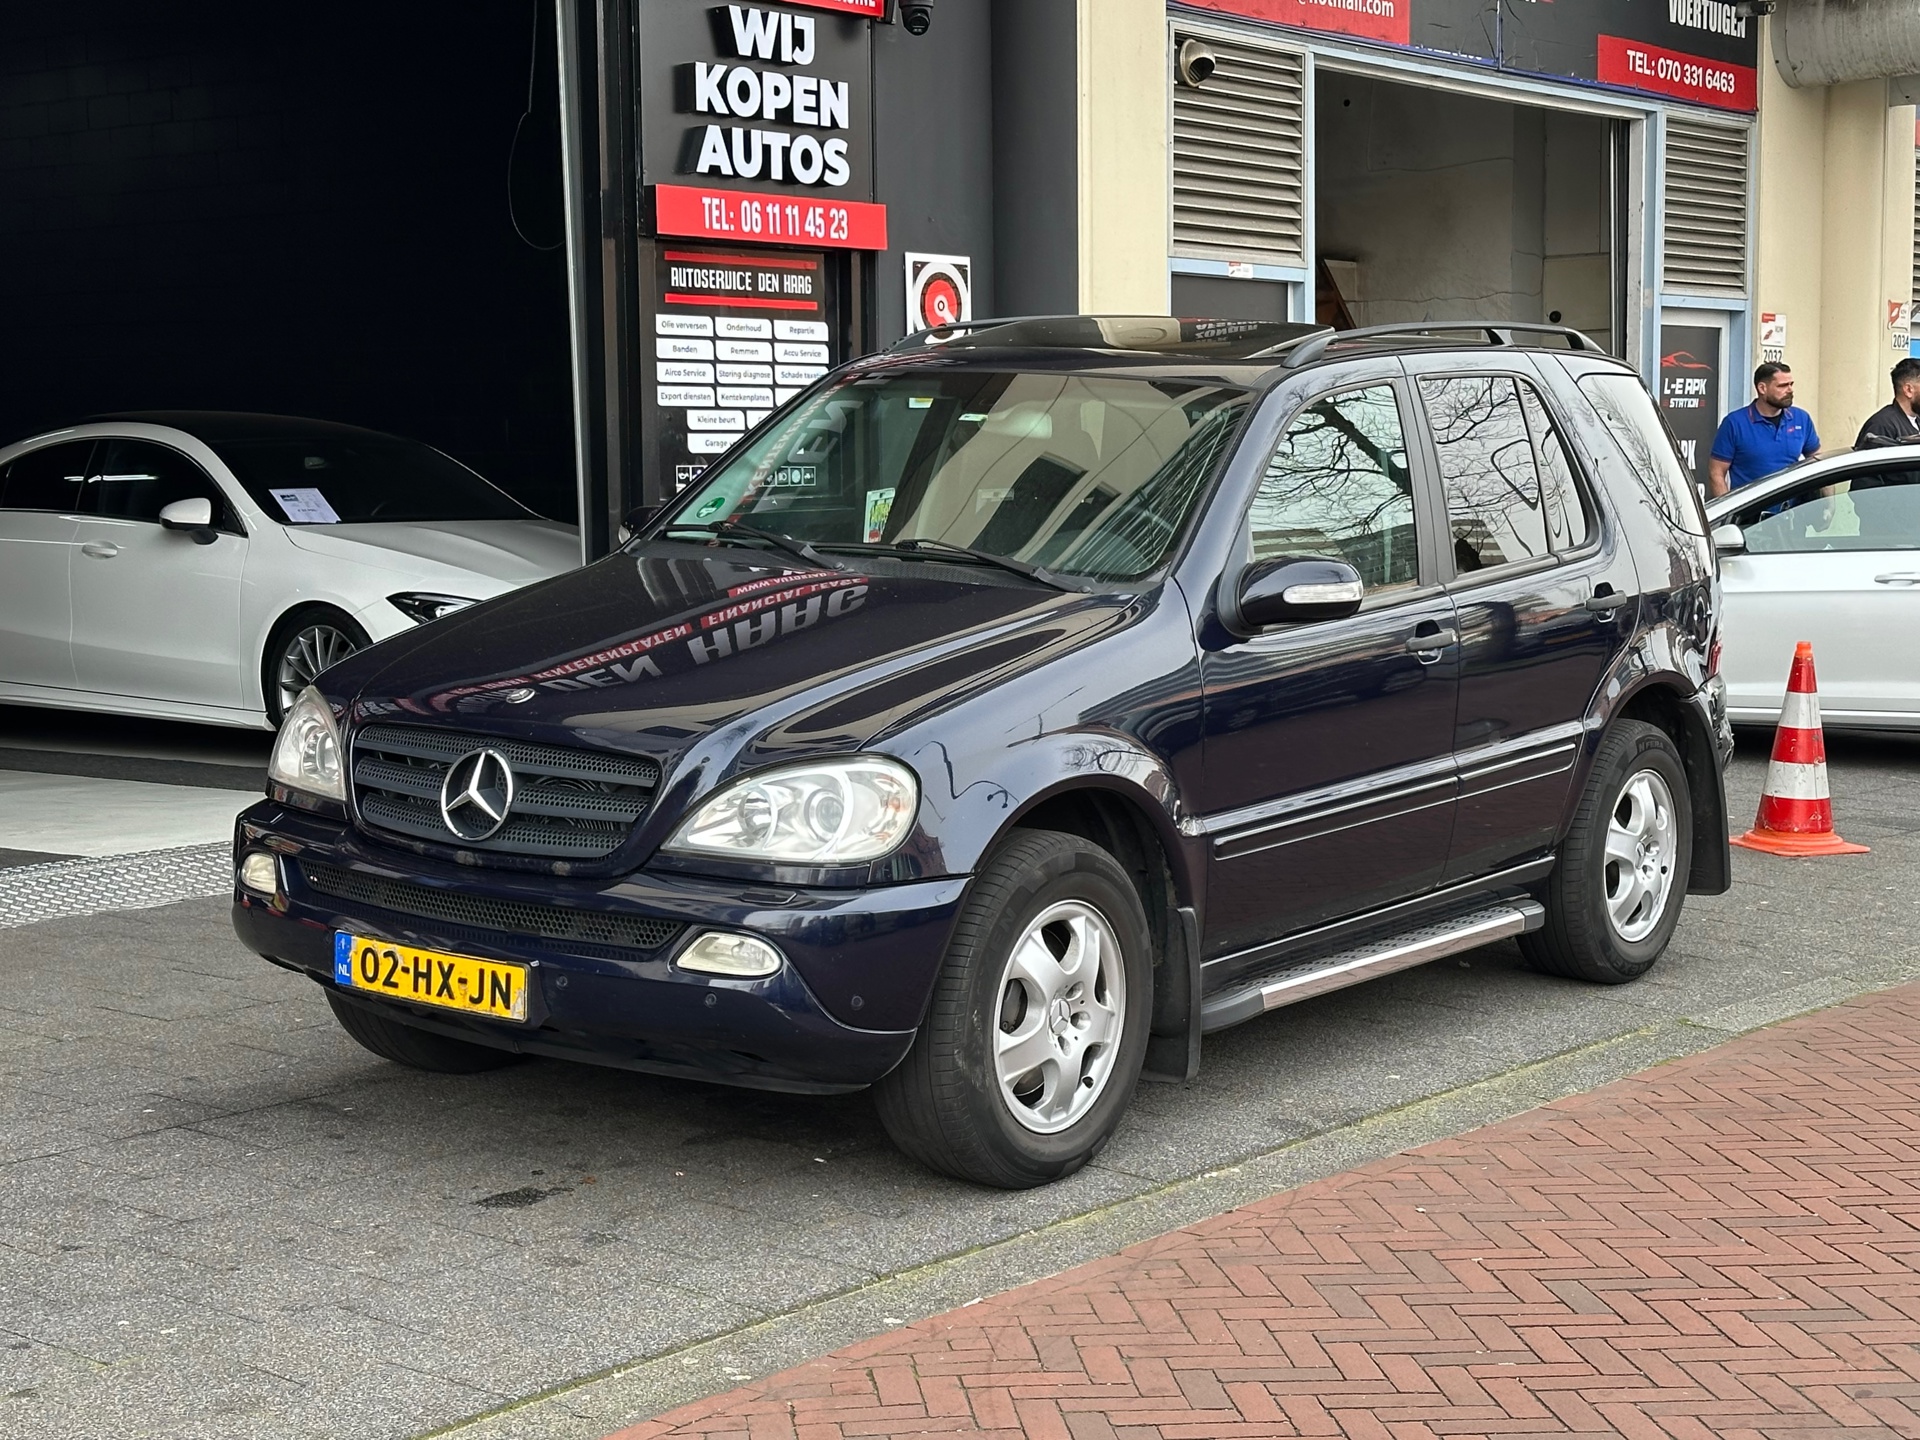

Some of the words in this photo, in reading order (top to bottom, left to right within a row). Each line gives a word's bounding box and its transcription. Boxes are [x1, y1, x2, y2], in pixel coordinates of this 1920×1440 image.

[728, 4, 815, 65] WIJ
[1626, 49, 1655, 77] TEL:
[1657, 57, 1681, 82] 070
[1683, 63, 1703, 87] 331
[1705, 68, 1735, 94] 6463
[695, 61, 849, 129] KOPEN
[696, 124, 850, 186] AUTOS
[701, 197, 734, 231] TEL:
[740, 200, 762, 234] 06
[766, 203, 781, 235] 11
[785, 204, 800, 236] 11
[804, 206, 825, 239] 45
[829, 208, 848, 240] 23
[671, 267, 753, 291] AUTOSERVICE
[758, 272, 779, 293] DEN
[783, 274, 812, 295] HAAG
[661, 320, 674, 329] Olie
[726, 323, 762, 332] Onderhoud
[672, 345, 698, 354] Banden
[731, 347, 759, 355] Remmen
[783, 349, 799, 357] Accu
[800, 350, 822, 358] Service
[1763, 349, 1783, 363] 2032
[664, 368, 682, 377] Airco
[683, 369, 707, 377] Service
[719, 370, 742, 379] Storing
[743, 370, 771, 380] diagnose
[781, 371, 803, 379] Schade
[660, 392, 682, 401] Export
[683, 392, 712, 401] diensten
[721, 393, 771, 403] Kentekenplaten
[1669, 397, 1699, 408] STATION
[697, 416, 717, 424] Kleine
[718, 416, 736, 424] beurt
[705, 440, 728, 448] Garage
[1678, 439, 1697, 470] PK
[338, 963, 350, 977] NL
[360, 947, 512, 1010] 02-HX-JN
